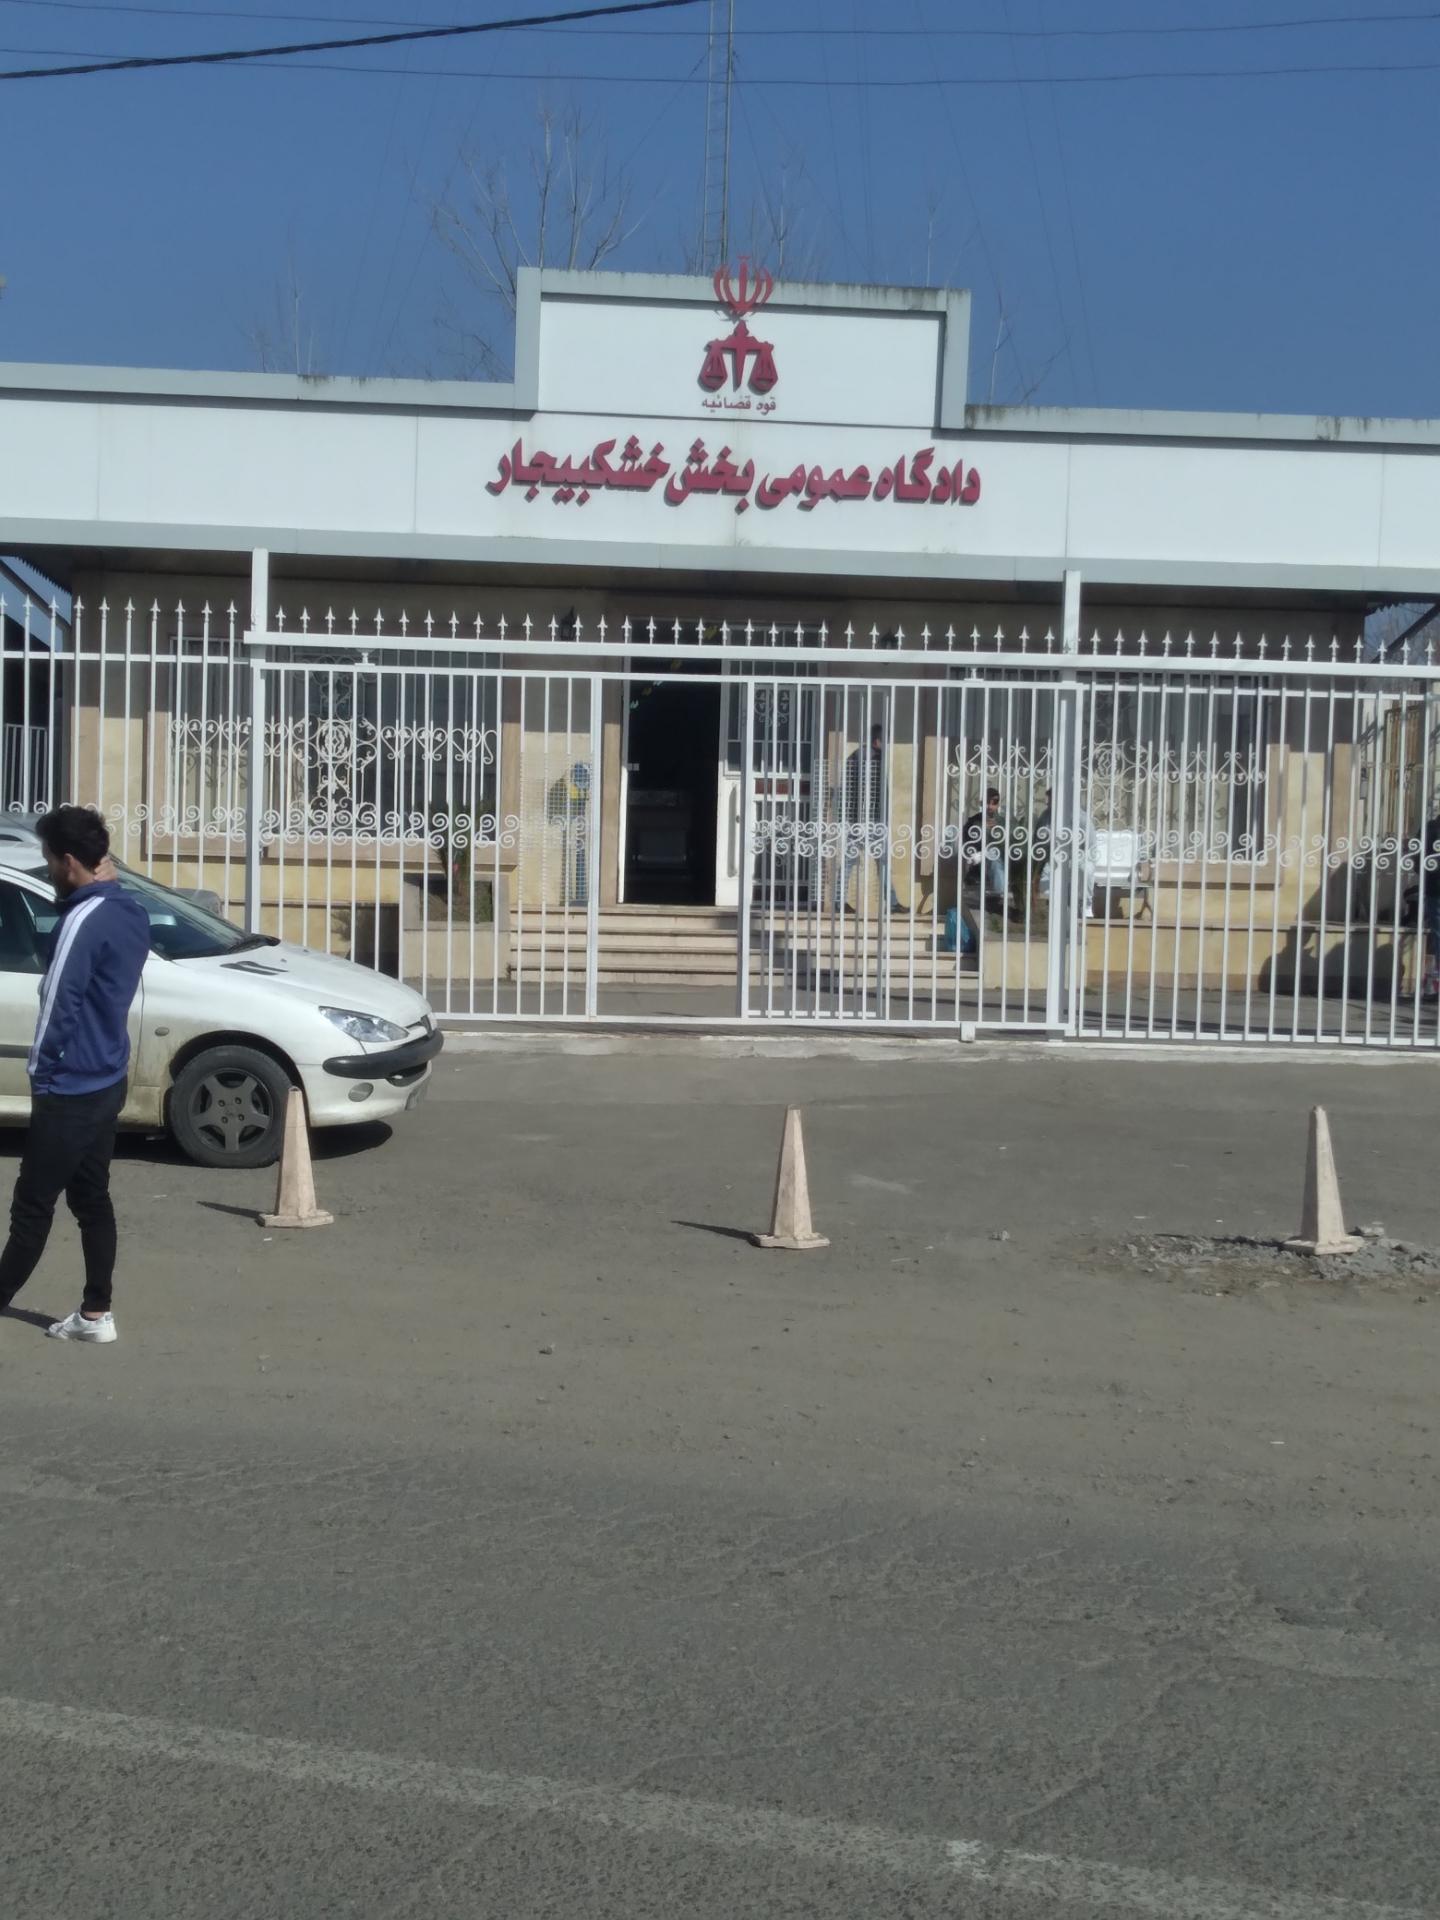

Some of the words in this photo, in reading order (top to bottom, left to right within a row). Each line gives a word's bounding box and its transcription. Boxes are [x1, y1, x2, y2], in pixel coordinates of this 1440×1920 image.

[756, 396, 776, 415] قوه
[485, 434, 671, 507] خشکبیجار
[663, 437, 755, 515] بخش
[755, 463, 873, 512] عمومی
[873, 446, 981, 506] دادگاه
